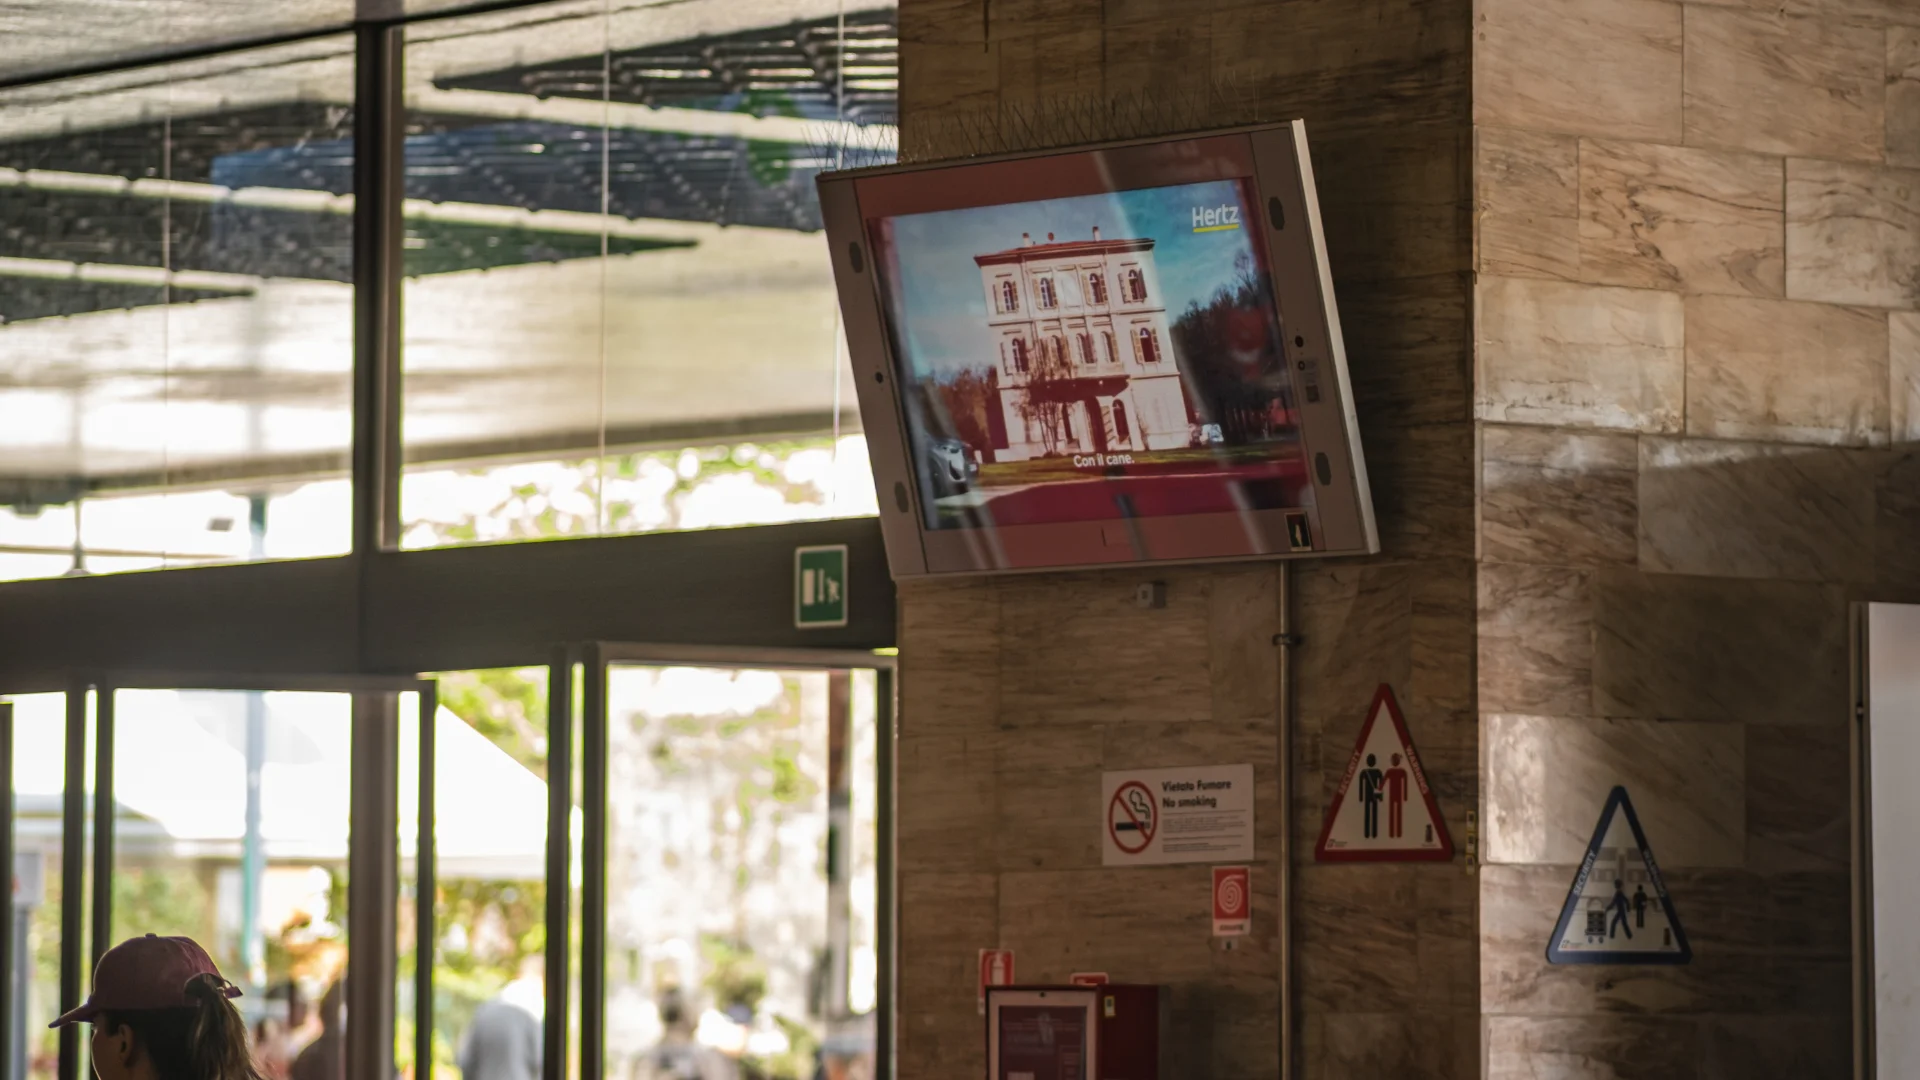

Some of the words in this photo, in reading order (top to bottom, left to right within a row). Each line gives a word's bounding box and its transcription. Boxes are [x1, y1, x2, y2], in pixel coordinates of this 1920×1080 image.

[1192, 204, 1239, 227] Hertz
[1073, 454, 1095, 468] Con
[1096, 453, 1104, 466] il
[1106, 453, 1135, 465] cane.
[1338, 749, 1360, 795] SECURITY
[1406, 744, 1429, 794] WARNING
[1162, 780, 1195, 792] Vietato
[1162, 797, 1176, 808] No
[1178, 795, 1217, 808] smoking
[1573, 849, 1596, 896] SECURITY
